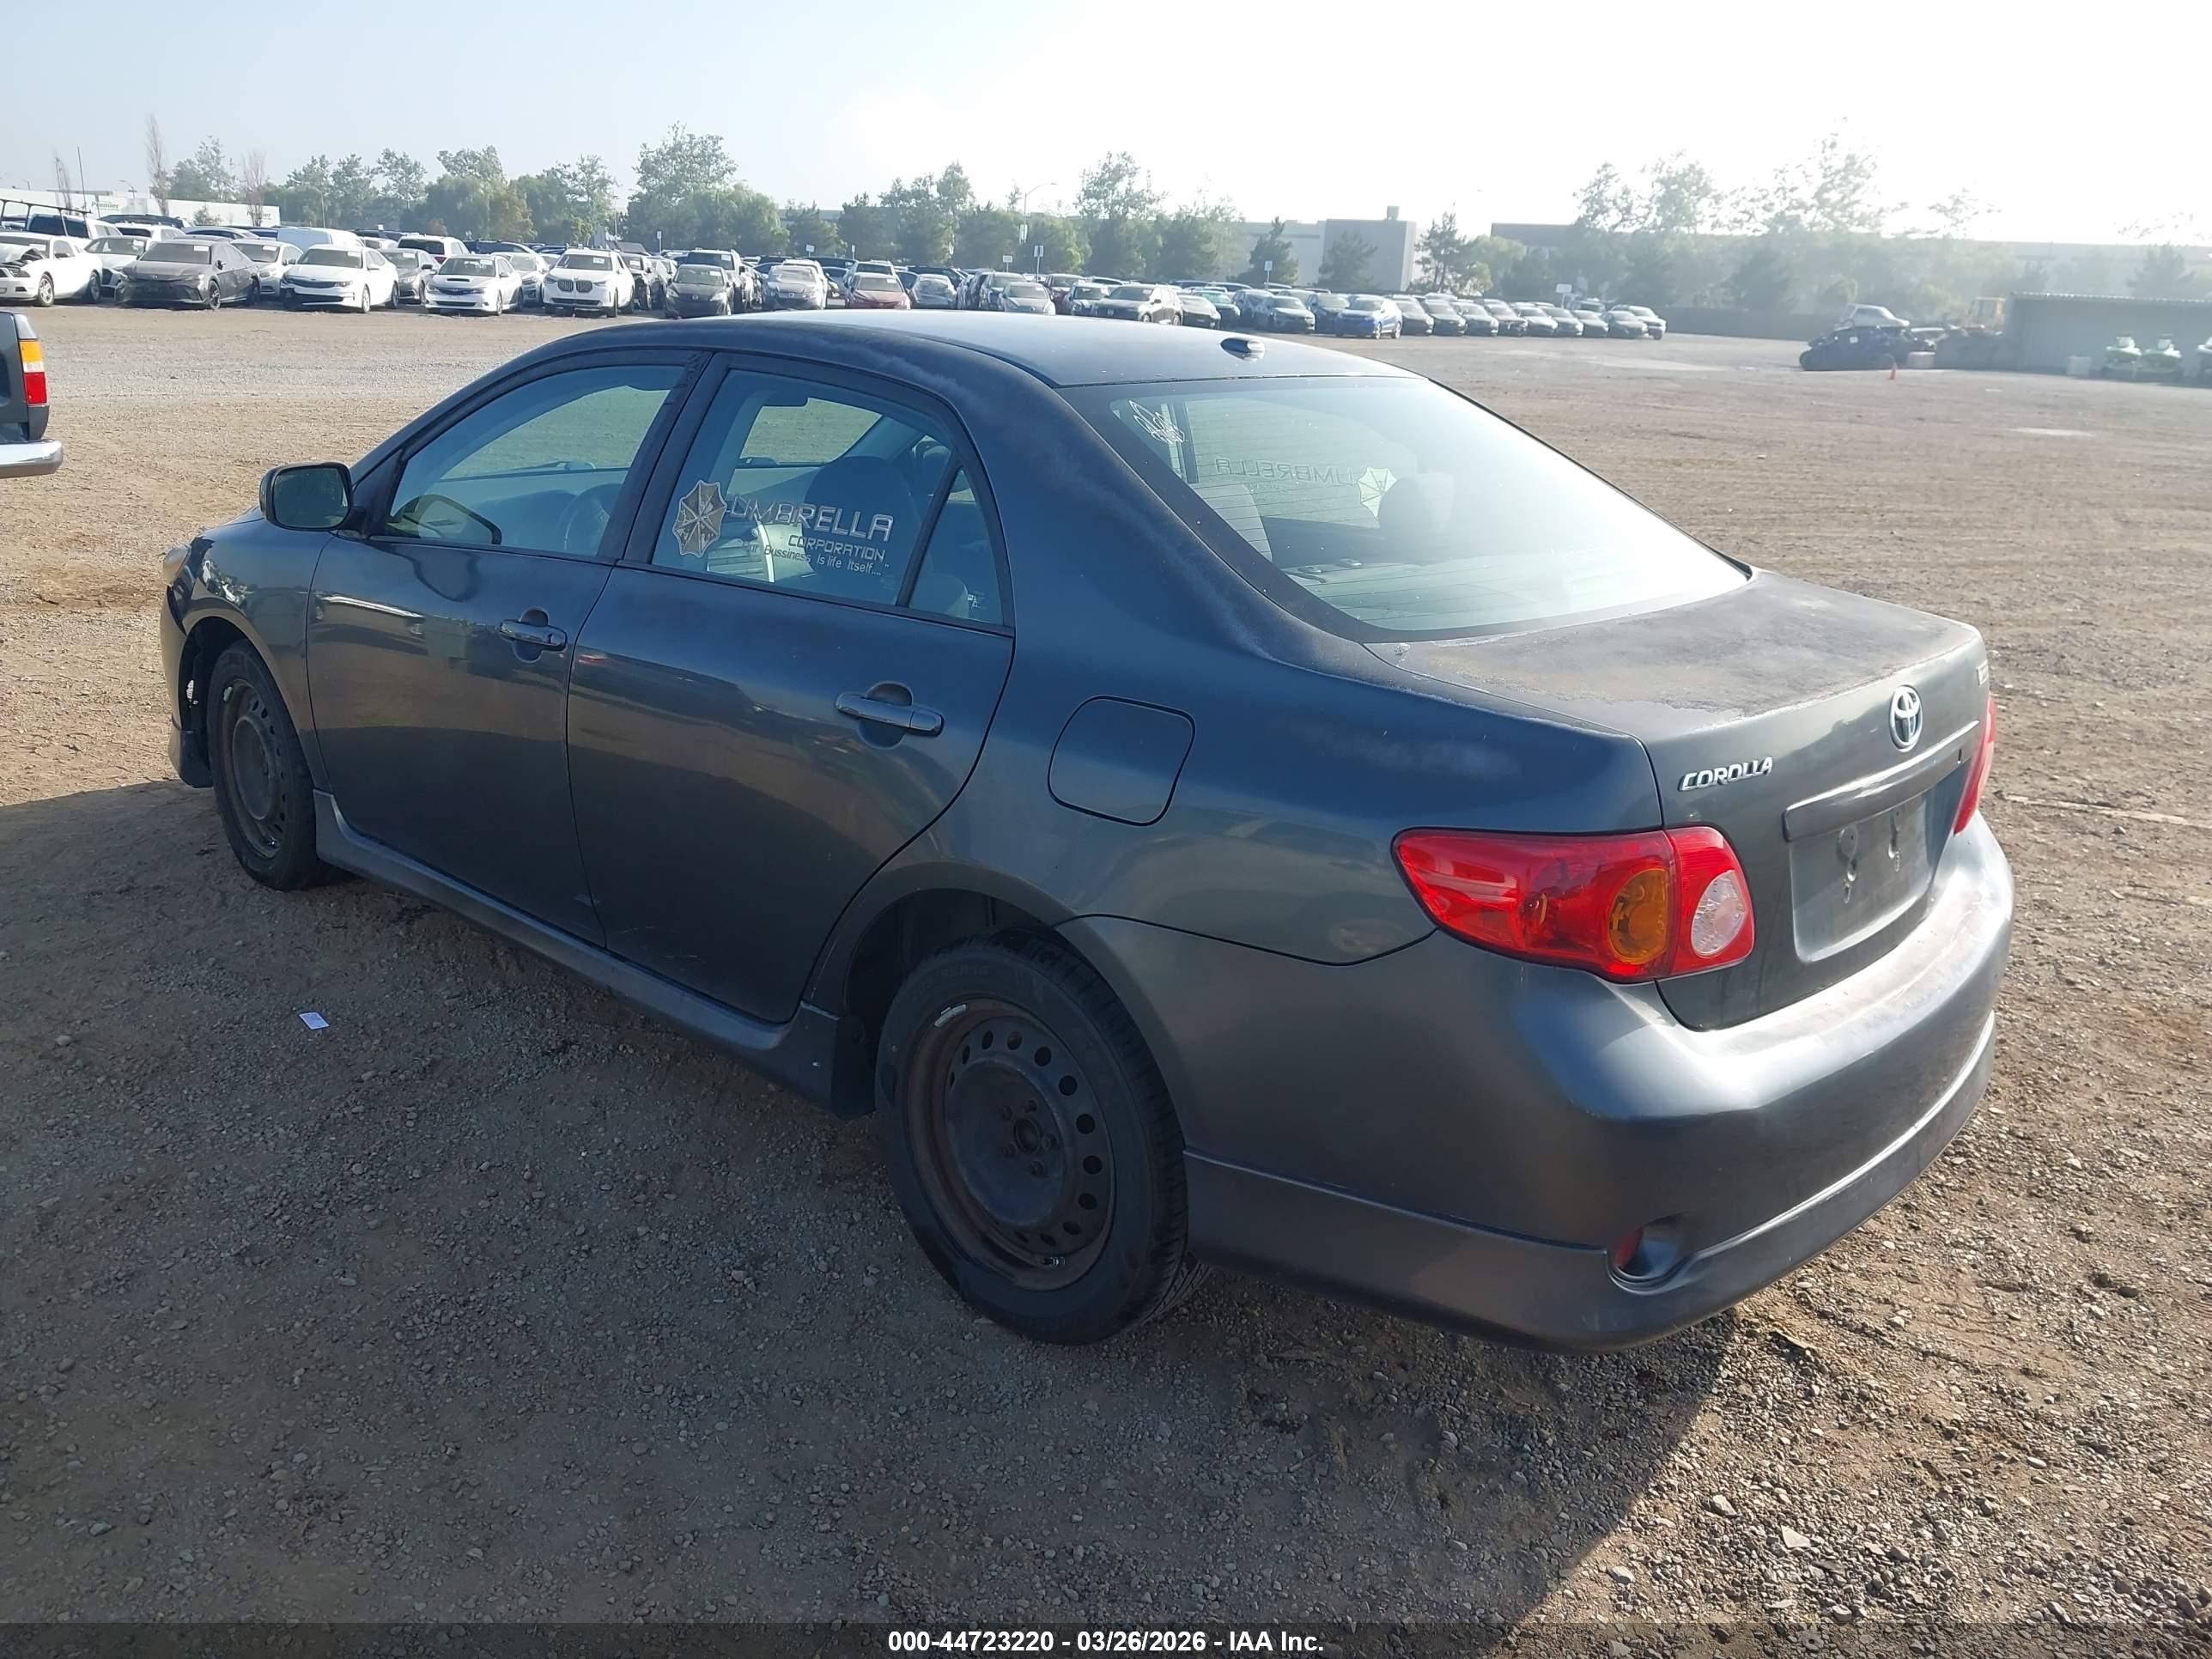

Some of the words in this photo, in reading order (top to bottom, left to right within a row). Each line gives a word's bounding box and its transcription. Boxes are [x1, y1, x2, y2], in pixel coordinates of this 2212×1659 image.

[730, 495, 894, 543] UMBRELLA
[787, 534, 886, 562] CORPORATION
[1679, 756, 1773, 792] COROLLA
